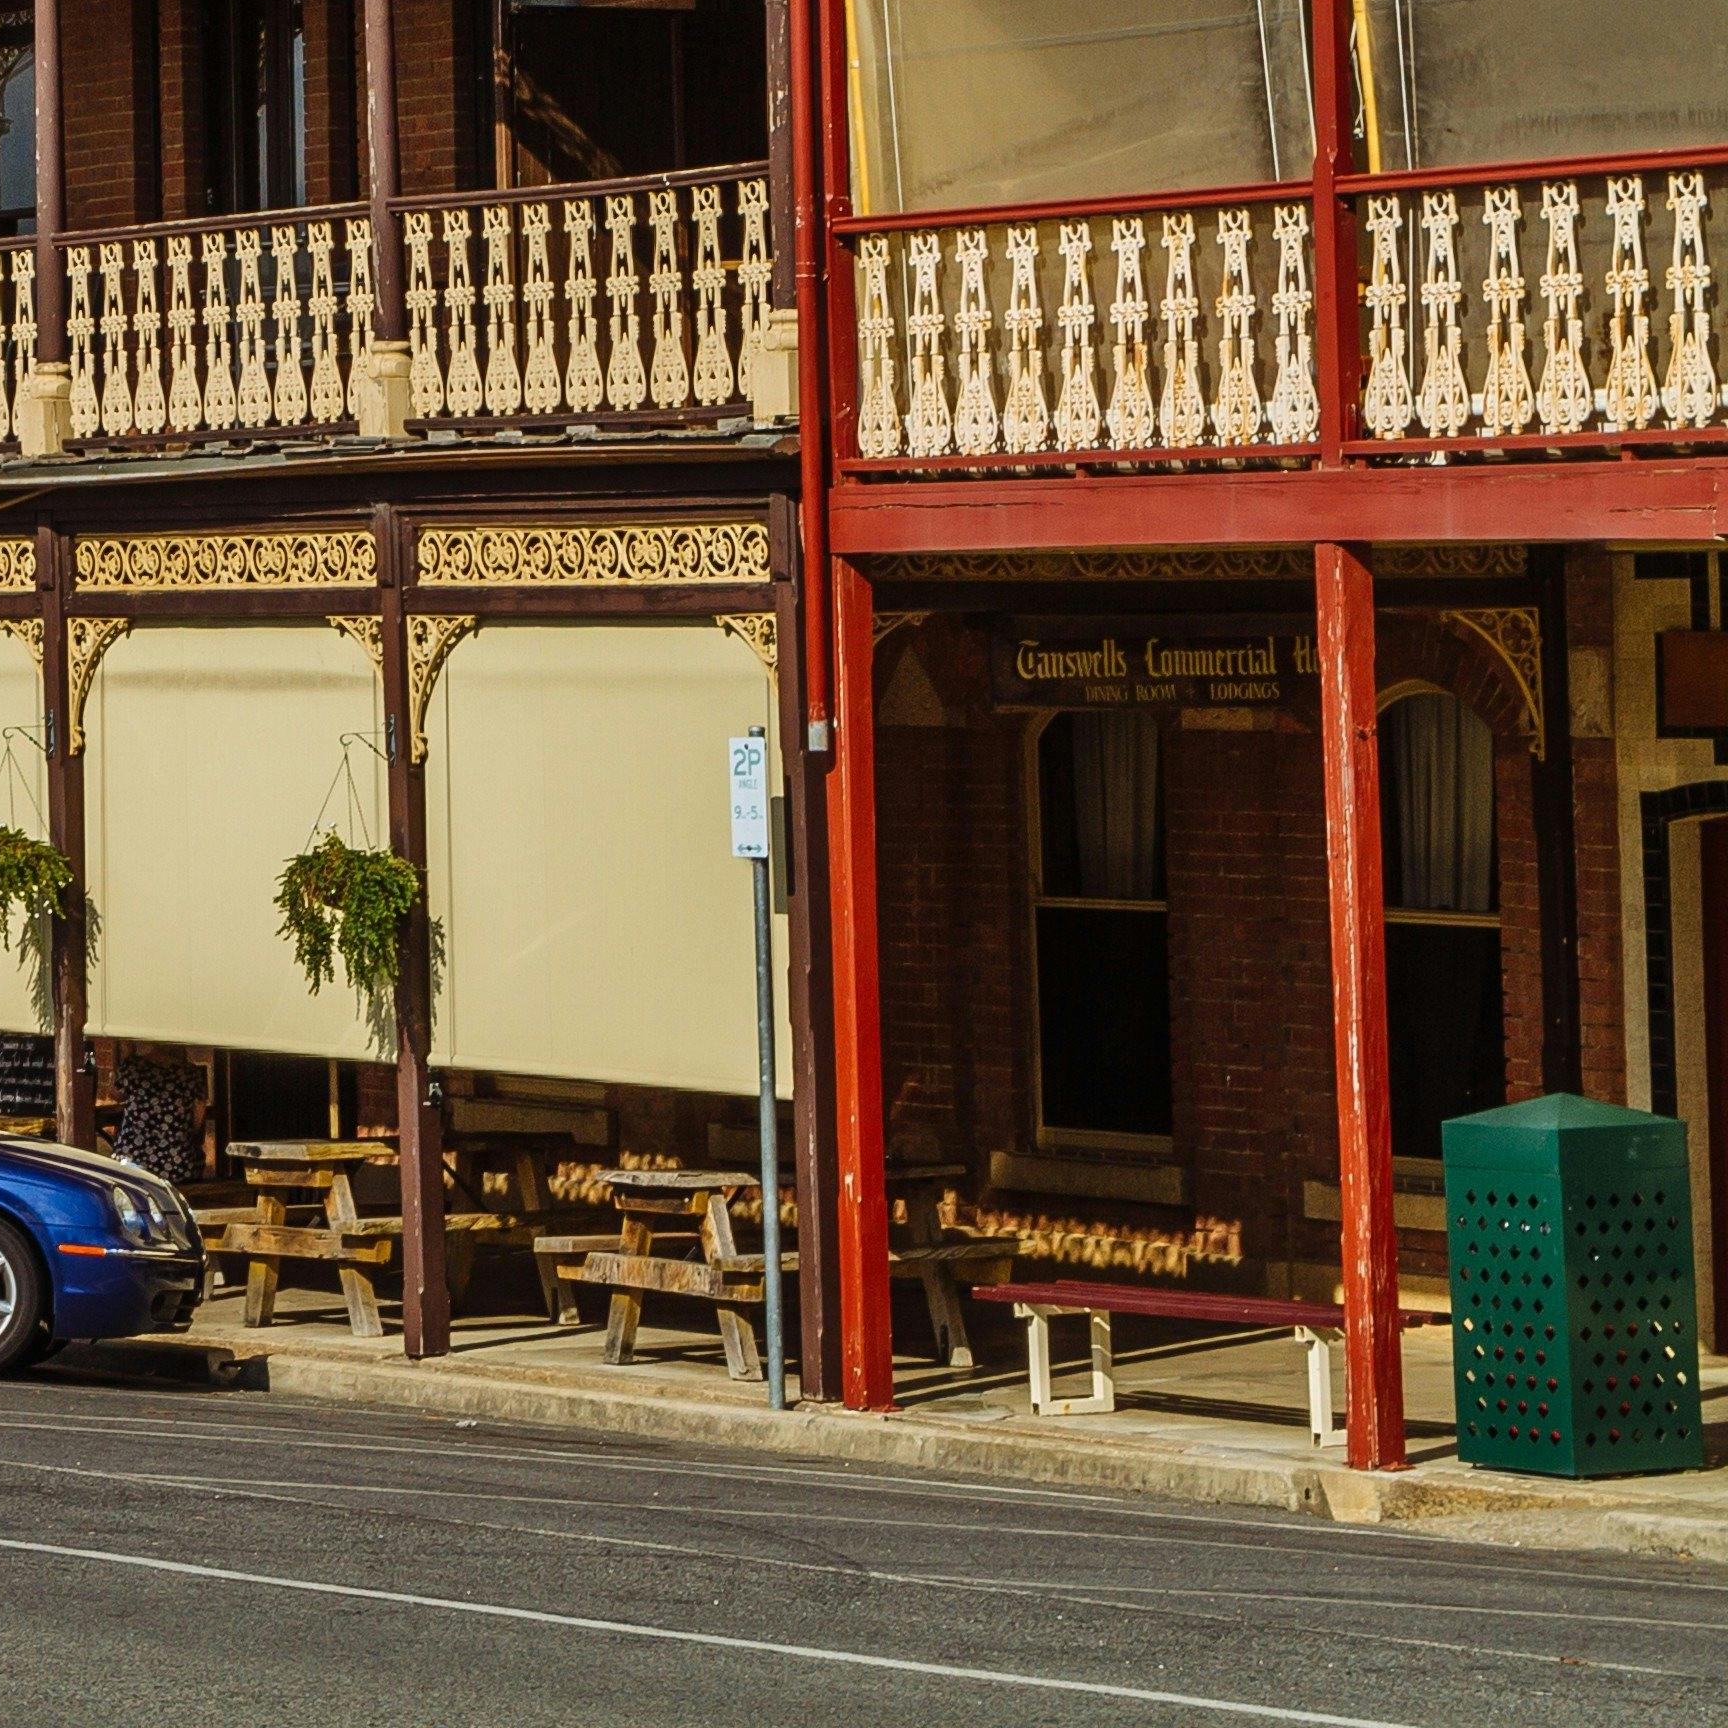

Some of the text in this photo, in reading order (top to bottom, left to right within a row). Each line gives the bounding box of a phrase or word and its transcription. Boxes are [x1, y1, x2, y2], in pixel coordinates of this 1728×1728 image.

[1016, 639, 1127, 679] Tanswells
[1146, 635, 1278, 677] Commercial
[1086, 682, 1280, 703] DINING ROOM LODGINGS
[733, 748, 761, 776] 2P
